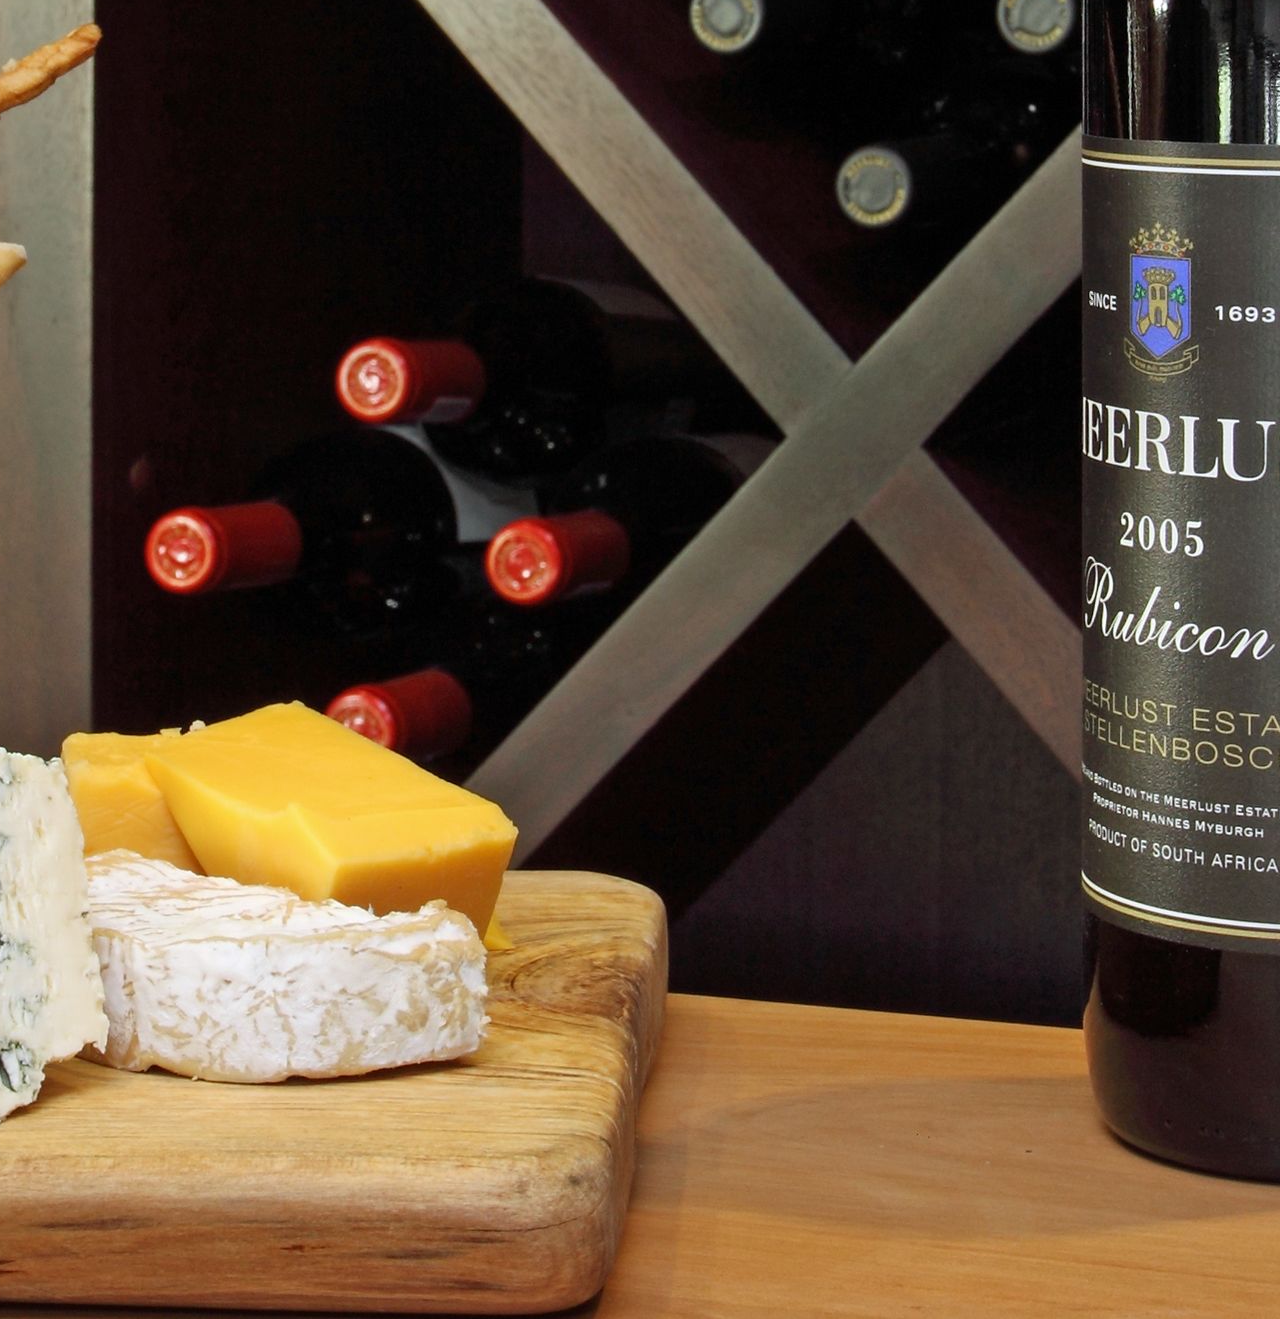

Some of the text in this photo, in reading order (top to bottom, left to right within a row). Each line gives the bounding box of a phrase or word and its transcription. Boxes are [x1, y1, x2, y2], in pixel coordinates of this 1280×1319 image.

[1088, 290, 1276, 323] SINCE 1693
[1119, 511, 1204, 557] 2005
[1084, 556, 1276, 660] Rubicon
[1085, 678, 1177, 726] EERLUST
[1093, 792, 1265, 838] PROPRIETOR HANNES MYBURGH
[1124, 786, 1137, 798] ON
[1140, 790, 1160, 804] THE
[1164, 794, 1230, 814] MEERLUST
[1088, 818, 1279, 873] PRODUCT OF SOUTH AFRICA
